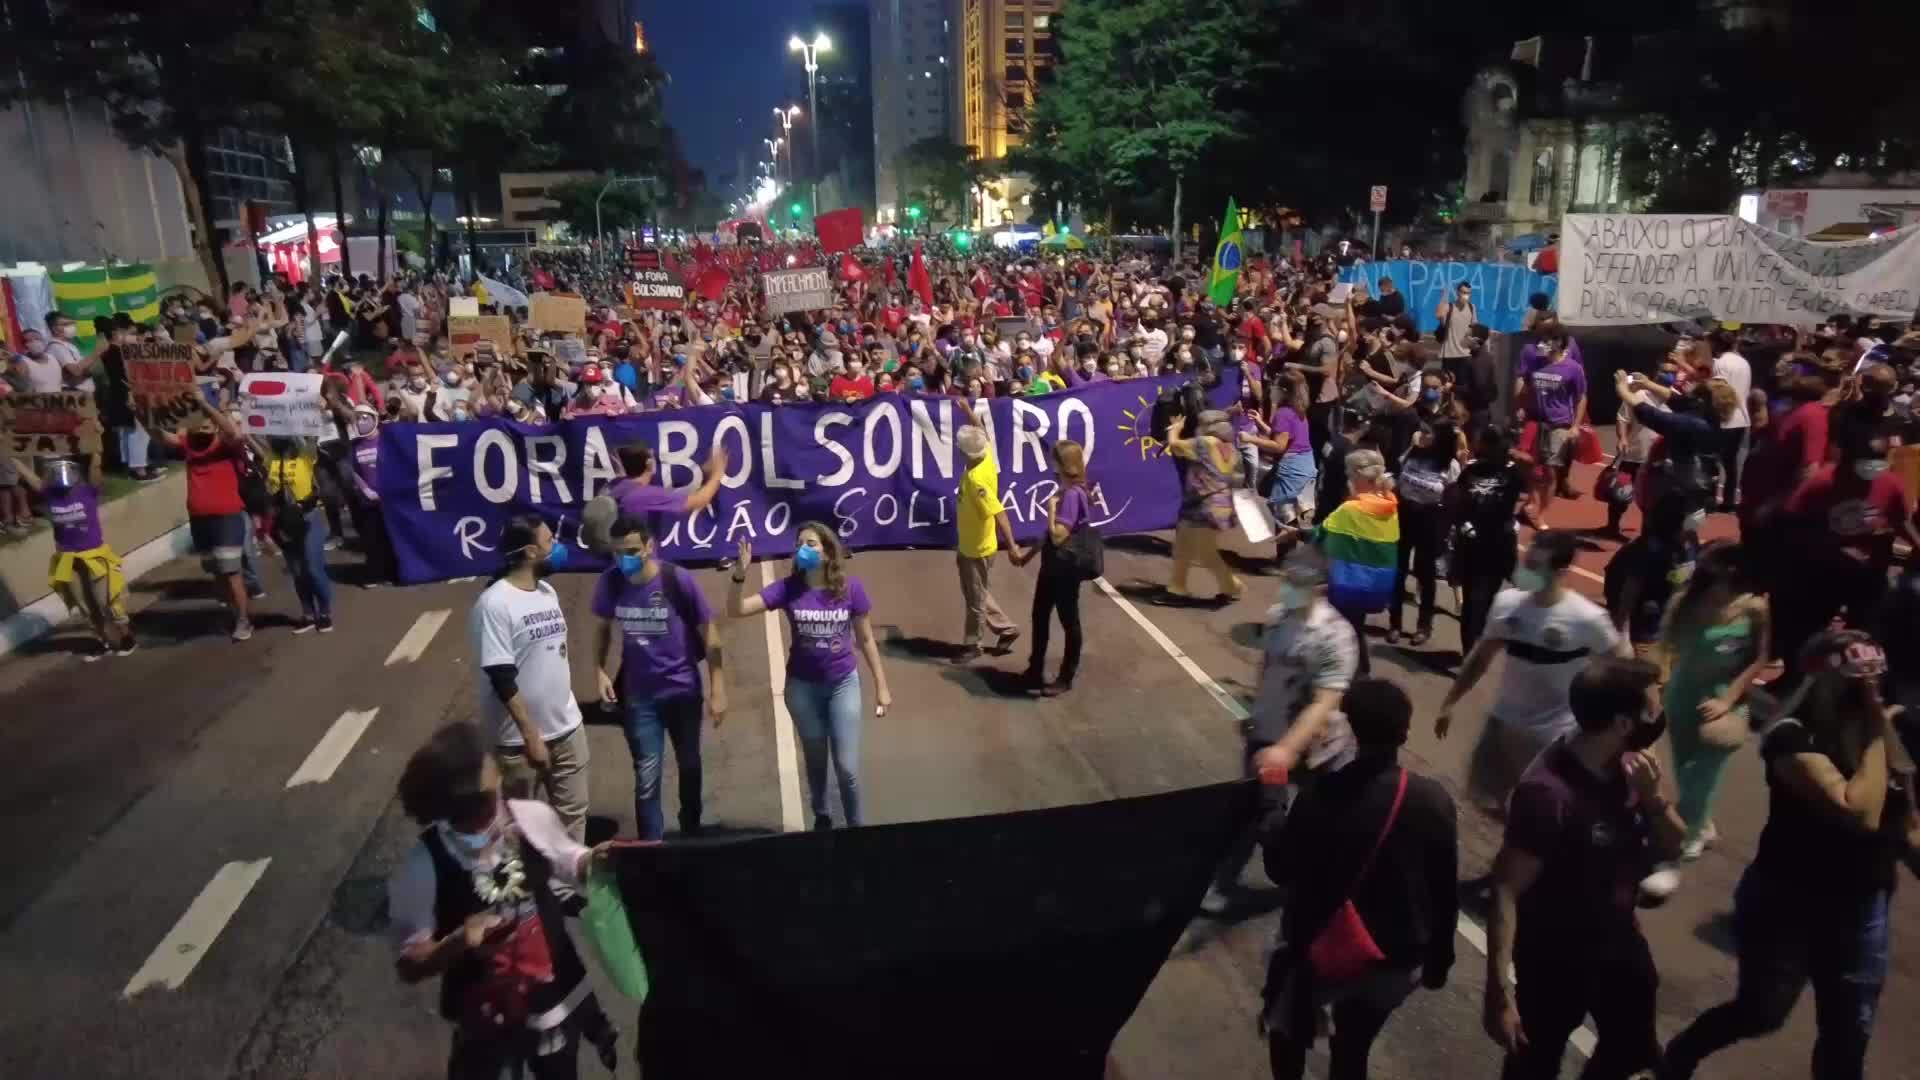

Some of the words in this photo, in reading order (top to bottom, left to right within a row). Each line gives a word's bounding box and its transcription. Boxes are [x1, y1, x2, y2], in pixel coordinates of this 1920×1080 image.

[1584, 218, 1670, 249] ABAIXO
[1680, 218, 1696, 249] O
[1583, 252, 1680, 285] DEFENDER
[632, 281, 684, 299] BOLSONARO
[415, 425, 617, 512] FORA
[656, 397, 1095, 491] BOLSONARO
[832, 478, 1133, 538] SOLIÁRA
[793, 608, 849, 622] REVOLUÇÃO
